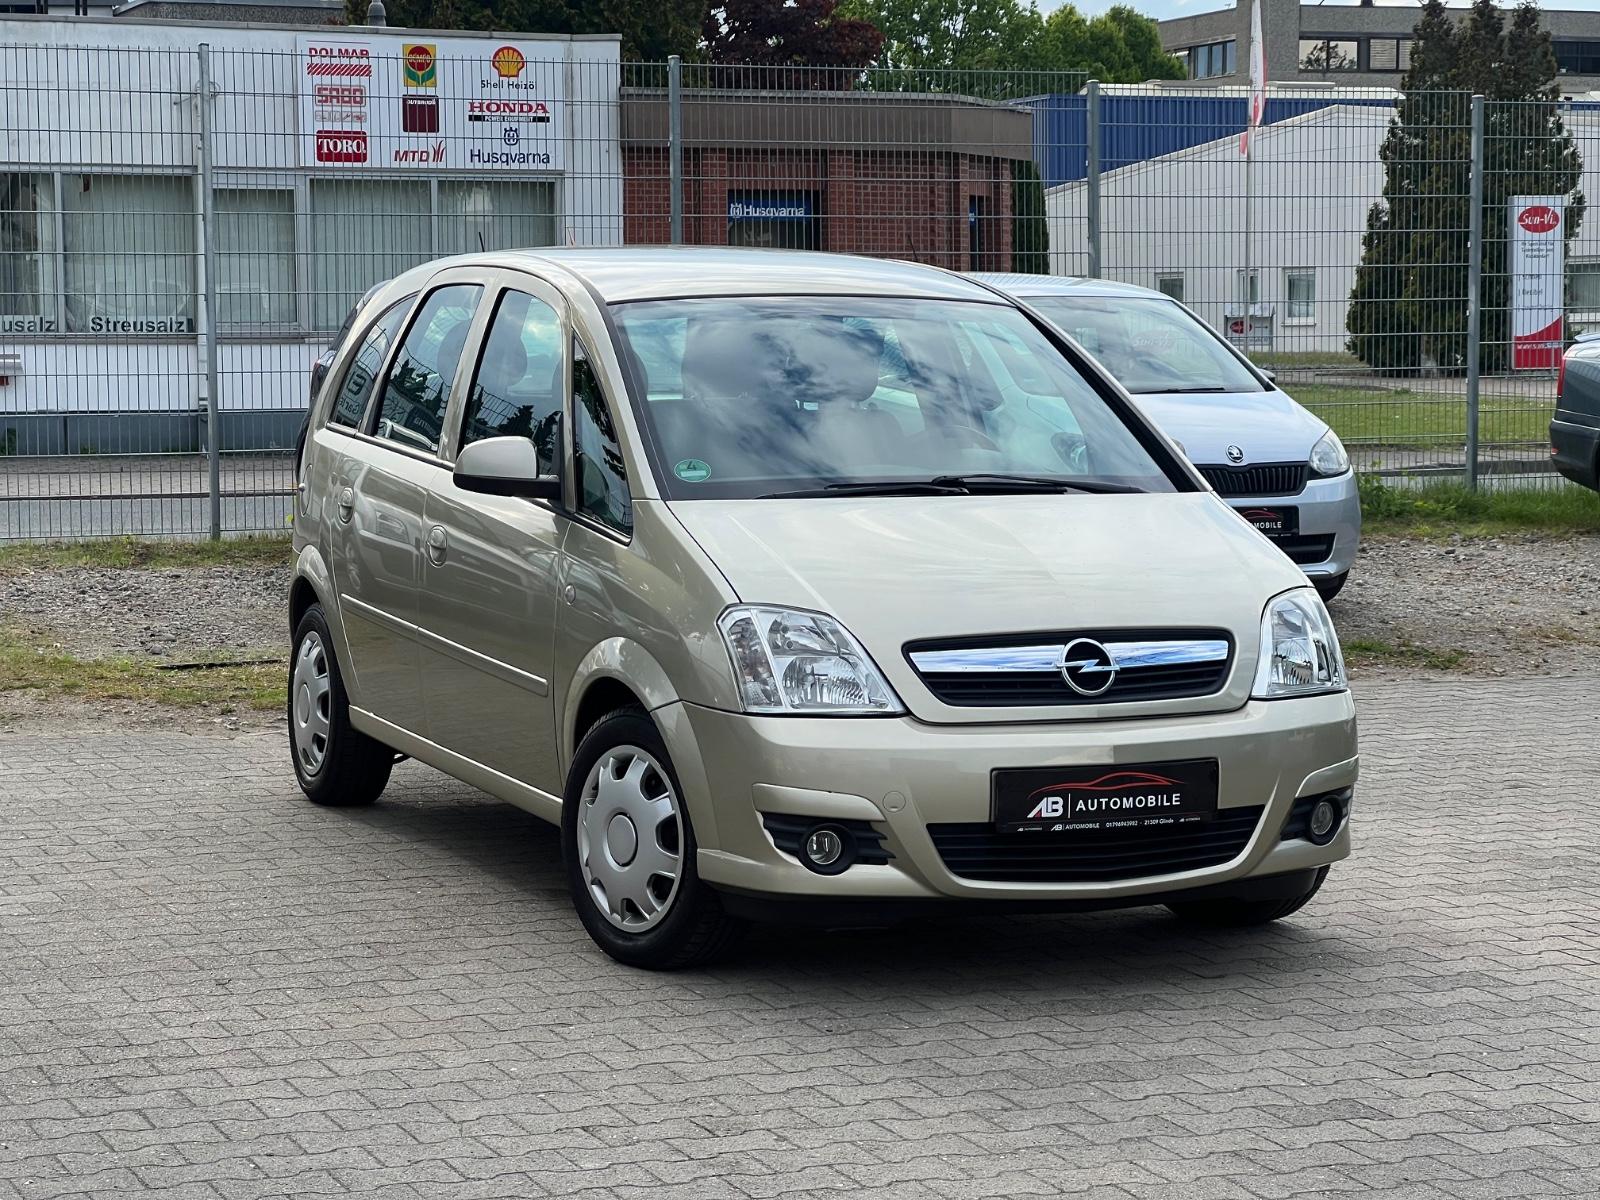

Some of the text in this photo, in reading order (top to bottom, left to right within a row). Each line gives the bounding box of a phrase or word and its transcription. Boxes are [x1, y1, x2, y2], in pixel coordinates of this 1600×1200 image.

[308, 48, 370, 59] DOLMAR
[481, 80, 503, 89] Shell
[468, 102, 550, 113] HONDA
[394, 150, 429, 162] MTD
[470, 149, 550, 166] Husqvarna
[743, 204, 805, 219] Husqvarna
[91, 316, 186, 333] Streusalz
[1075, 793, 1182, 812] AUTOMOBILE
[1065, 822, 1100, 830] AUTOMOBILE
